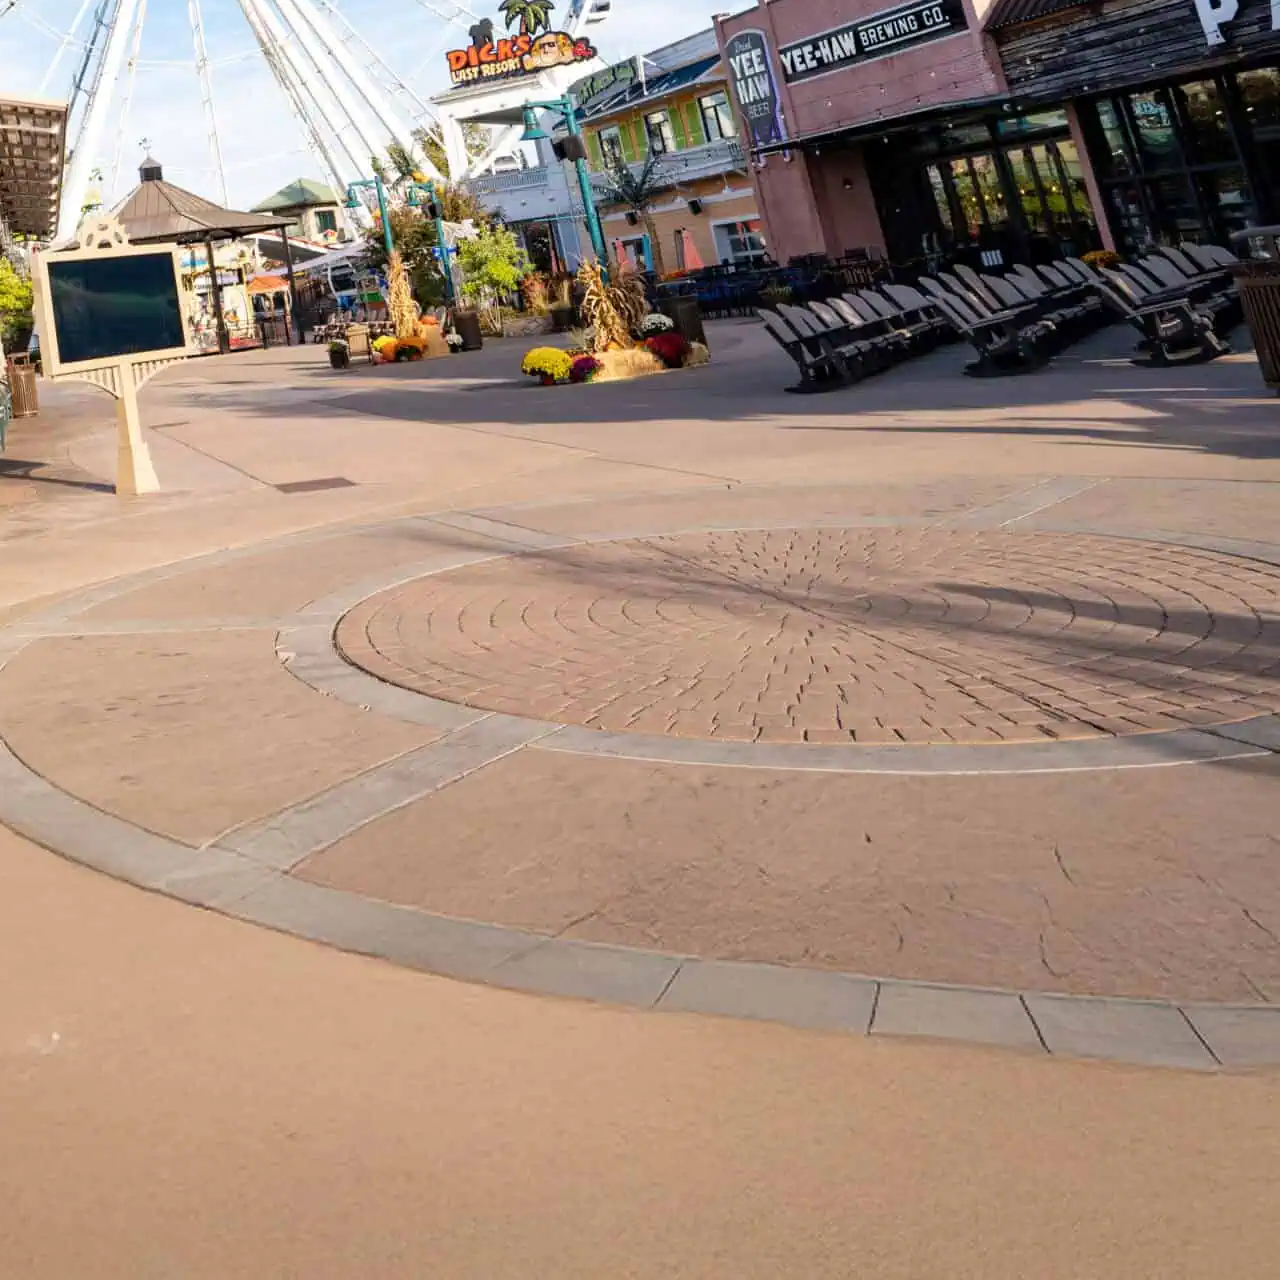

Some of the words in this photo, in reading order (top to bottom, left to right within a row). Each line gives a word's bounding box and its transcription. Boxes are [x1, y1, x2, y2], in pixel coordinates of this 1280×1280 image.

[859, 15, 919, 46] BREWING
[922, 6, 950, 26] CO.
[447, 35, 532, 71] DICK'S
[452, 66, 478, 82] LAST
[482, 55, 521, 78] RESORT
[729, 47, 767, 80] YEE
[736, 73, 770, 105] HAW
